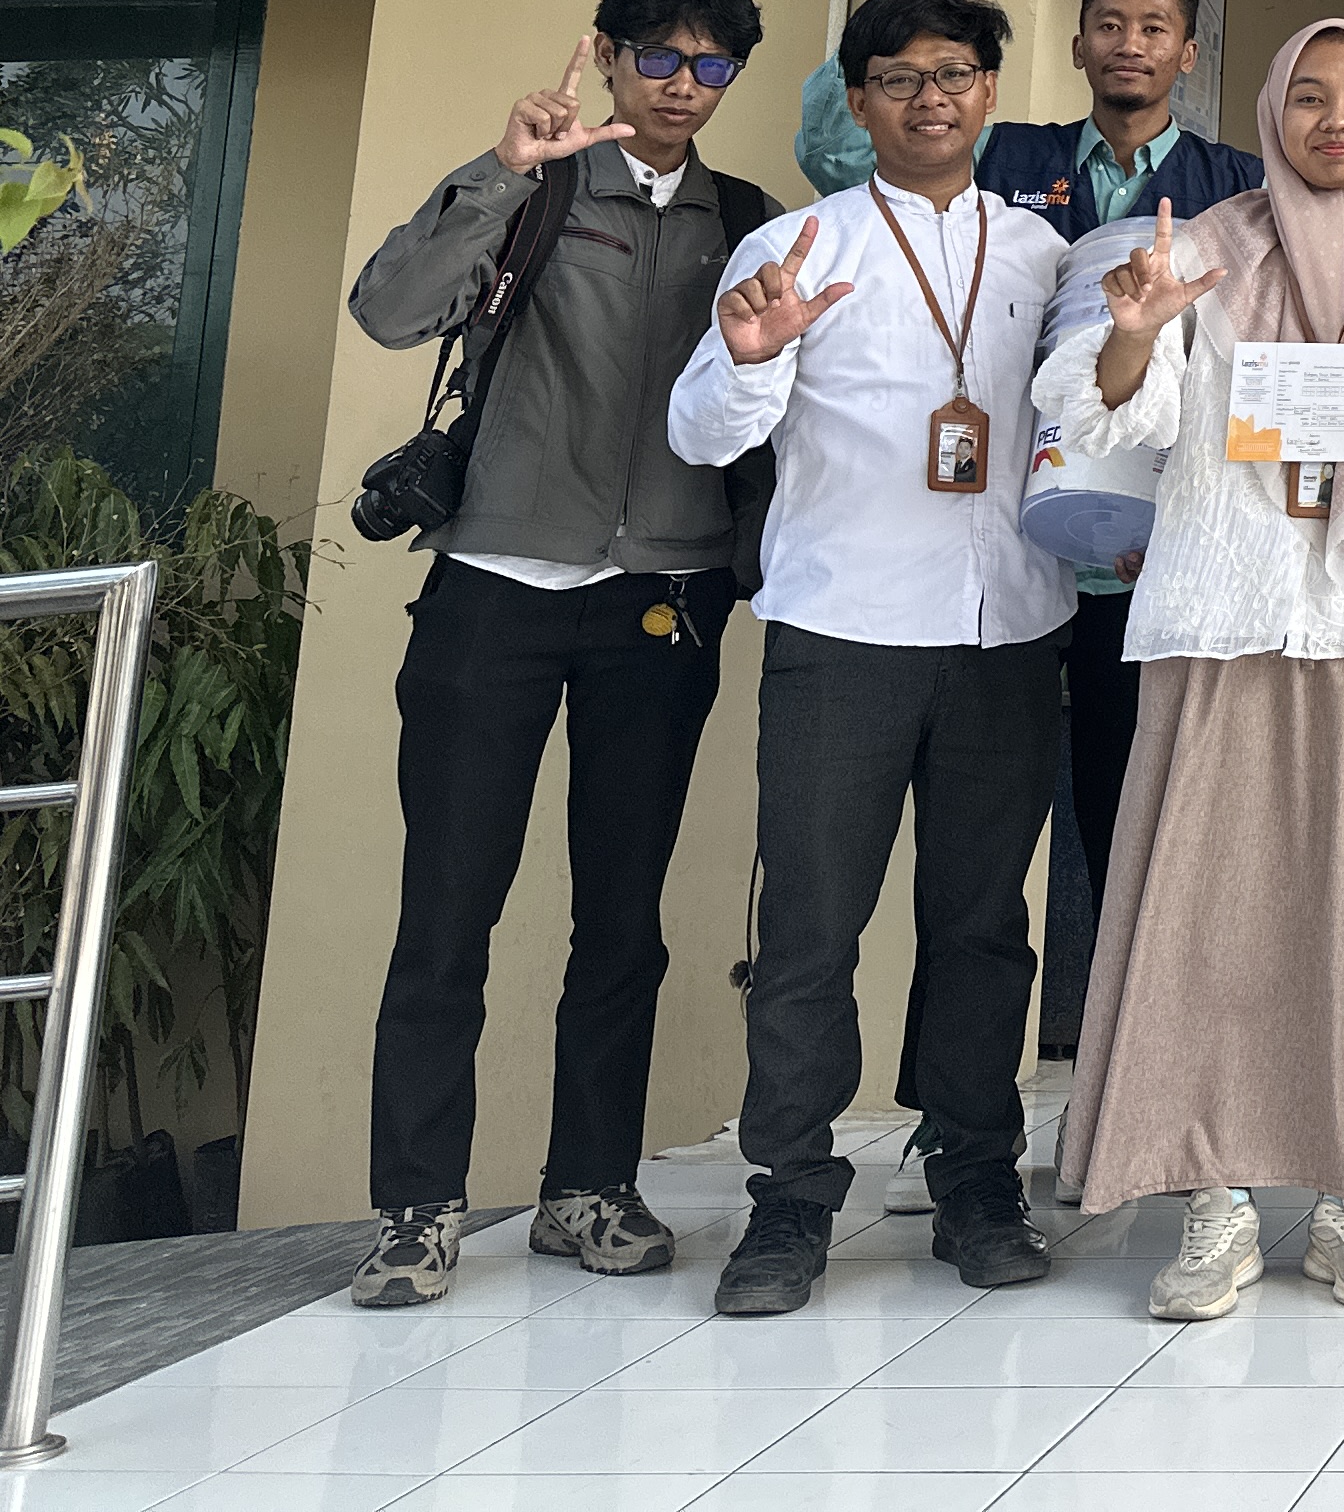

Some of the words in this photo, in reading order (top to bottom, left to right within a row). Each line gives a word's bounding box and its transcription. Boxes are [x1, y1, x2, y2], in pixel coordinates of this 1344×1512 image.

[1013, 190, 1071, 205] lazismu
[488, 272, 513, 315] Canon
[1037, 425, 1062, 449] PED
